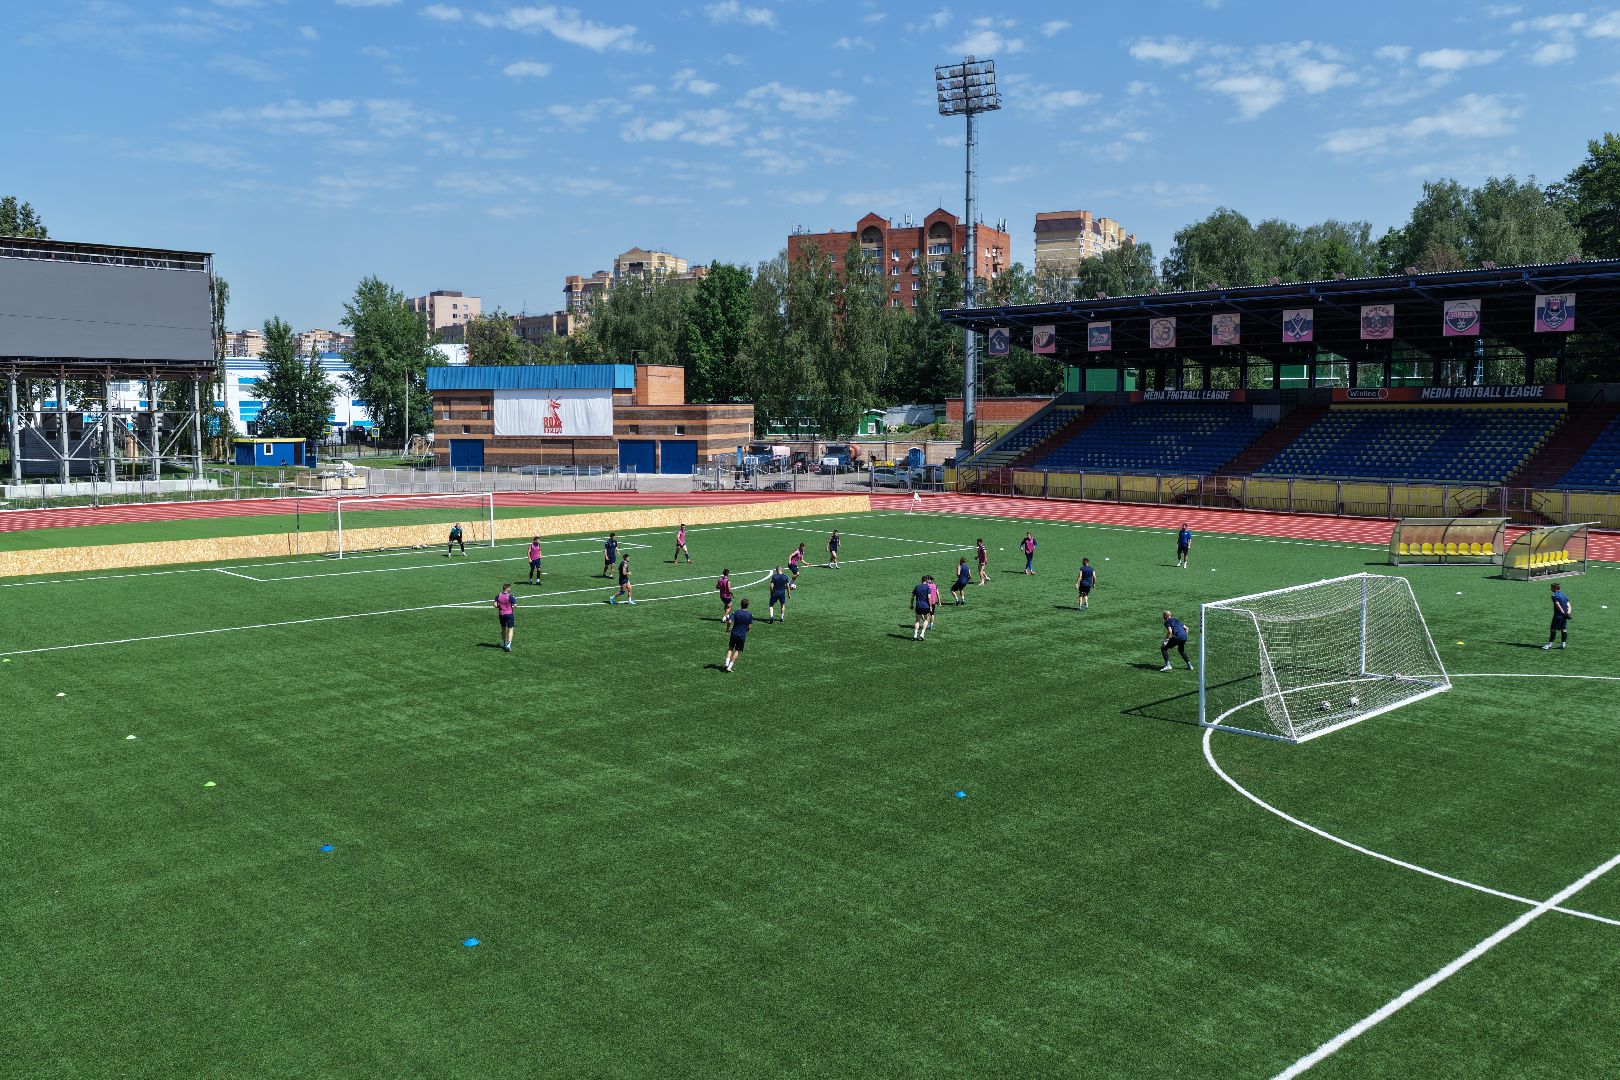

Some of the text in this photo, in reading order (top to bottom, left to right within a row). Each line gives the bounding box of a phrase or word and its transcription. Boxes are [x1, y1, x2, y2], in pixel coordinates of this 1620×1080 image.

[1143, 390, 1230, 400] MEDIA FOOTBALL LEAGUE
[1421, 385, 1544, 398] MEDIA FOOTBALL LEAGUE
